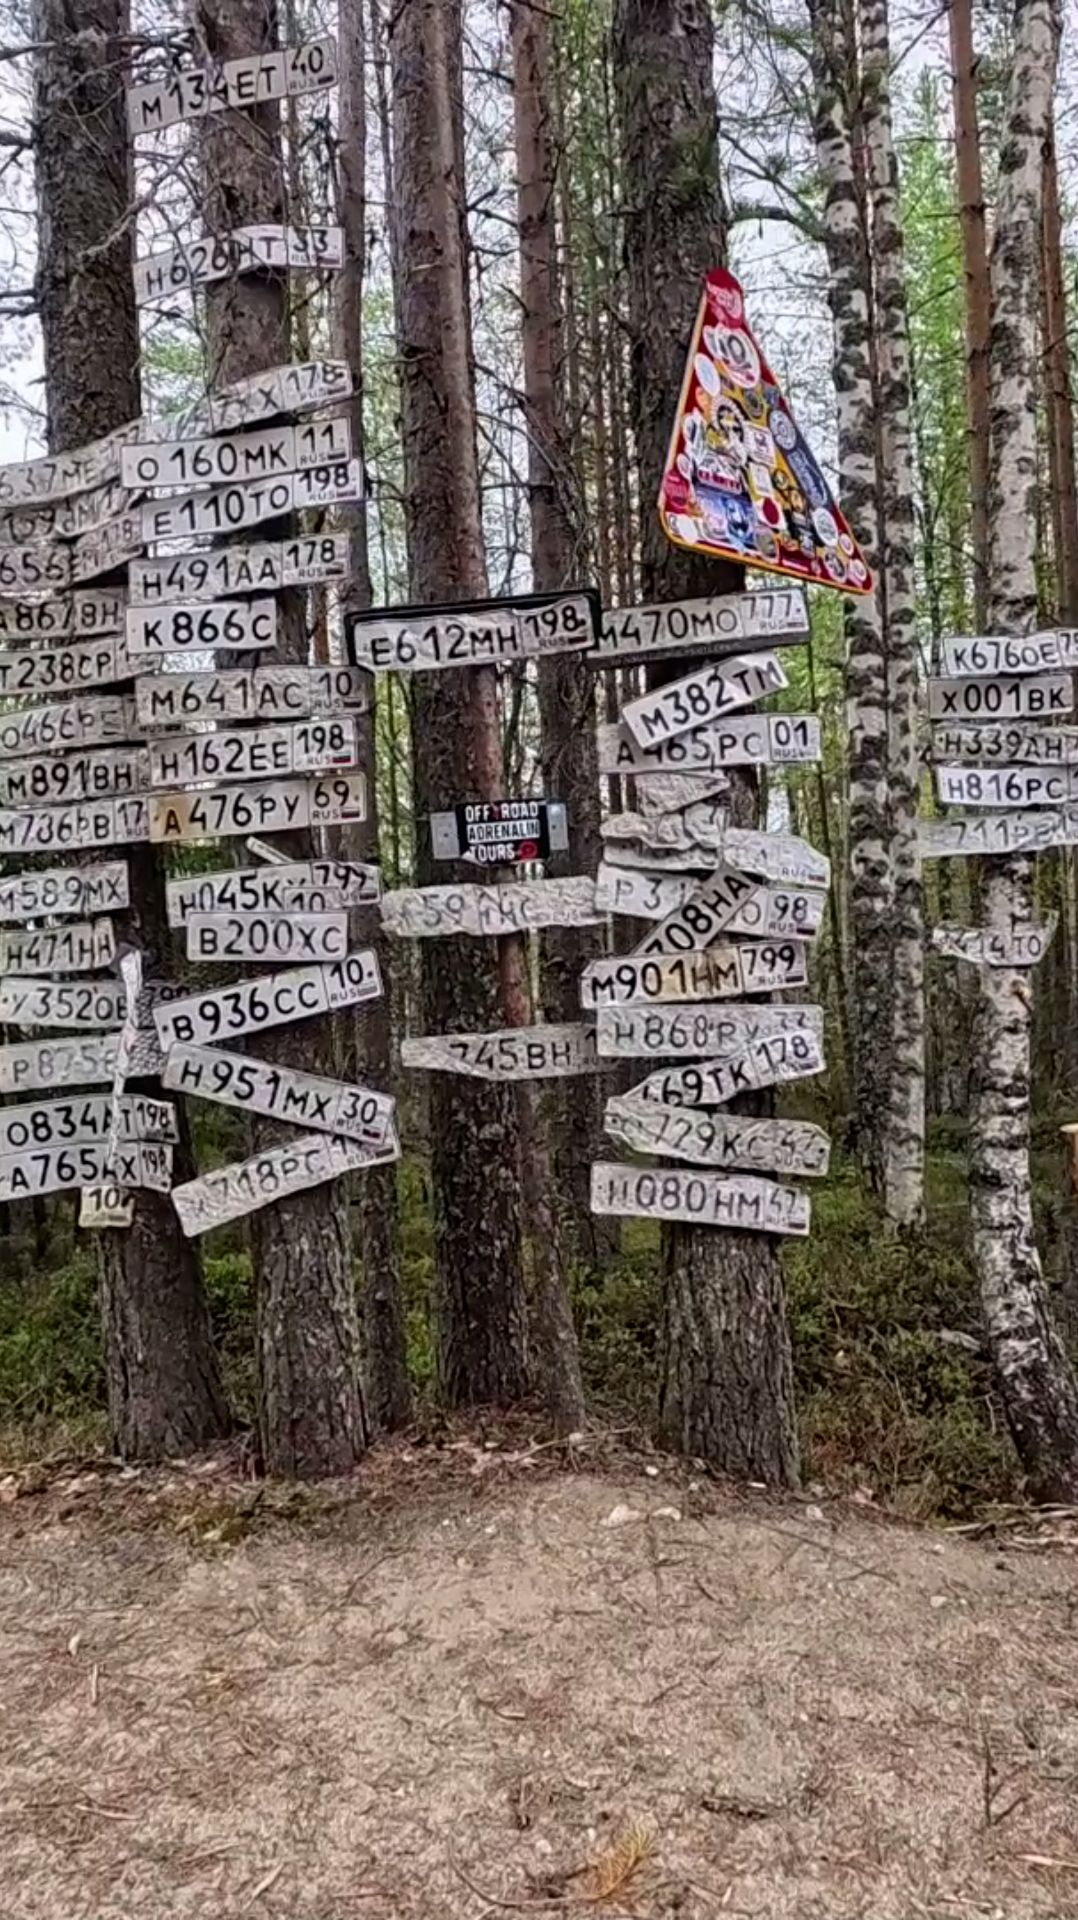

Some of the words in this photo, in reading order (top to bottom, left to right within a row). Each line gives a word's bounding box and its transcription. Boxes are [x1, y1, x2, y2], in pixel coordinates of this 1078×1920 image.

[291, 46, 324, 75] 40
[286, 364, 338, 391] 178
[137, 441, 287, 481] О160МК
[301, 424, 334, 452] 11
[155, 485, 289, 536] Е110ТО
[299, 464, 350, 493] 198
[287, 539, 335, 568] 178
[742, 593, 792, 619] 777
[144, 610, 271, 647] К866С
[370, 623, 518, 666] Е612МН
[525, 604, 581, 638] 198
[318, 672, 351, 697] 10
[942, 683, 1066, 713] Х001ВК
[774, 720, 808, 747] 01
[161, 737, 288, 780] Н162ЕЕ
[297, 723, 345, 755] 198
[948, 772, 1063, 801] Н816РС
[165, 793, 299, 836] А476РУ
[314, 780, 350, 808] 69
[313, 809, 339, 820] RUS
[465, 804, 490, 822] OFF
[500, 801, 539, 819] ROAD
[468, 821, 539, 841] ADRENALIN
[468, 843, 515, 861] TOURS
[200, 919, 342, 955] В200ХС
[742, 945, 796, 975] 799
[172, 982, 320, 1042] В936СС
[330, 958, 364, 989] 10
[756, 1035, 809, 1071] 178
[180, 1059, 332, 1122] Н951МХ
[343, 1092, 378, 1125] 30
